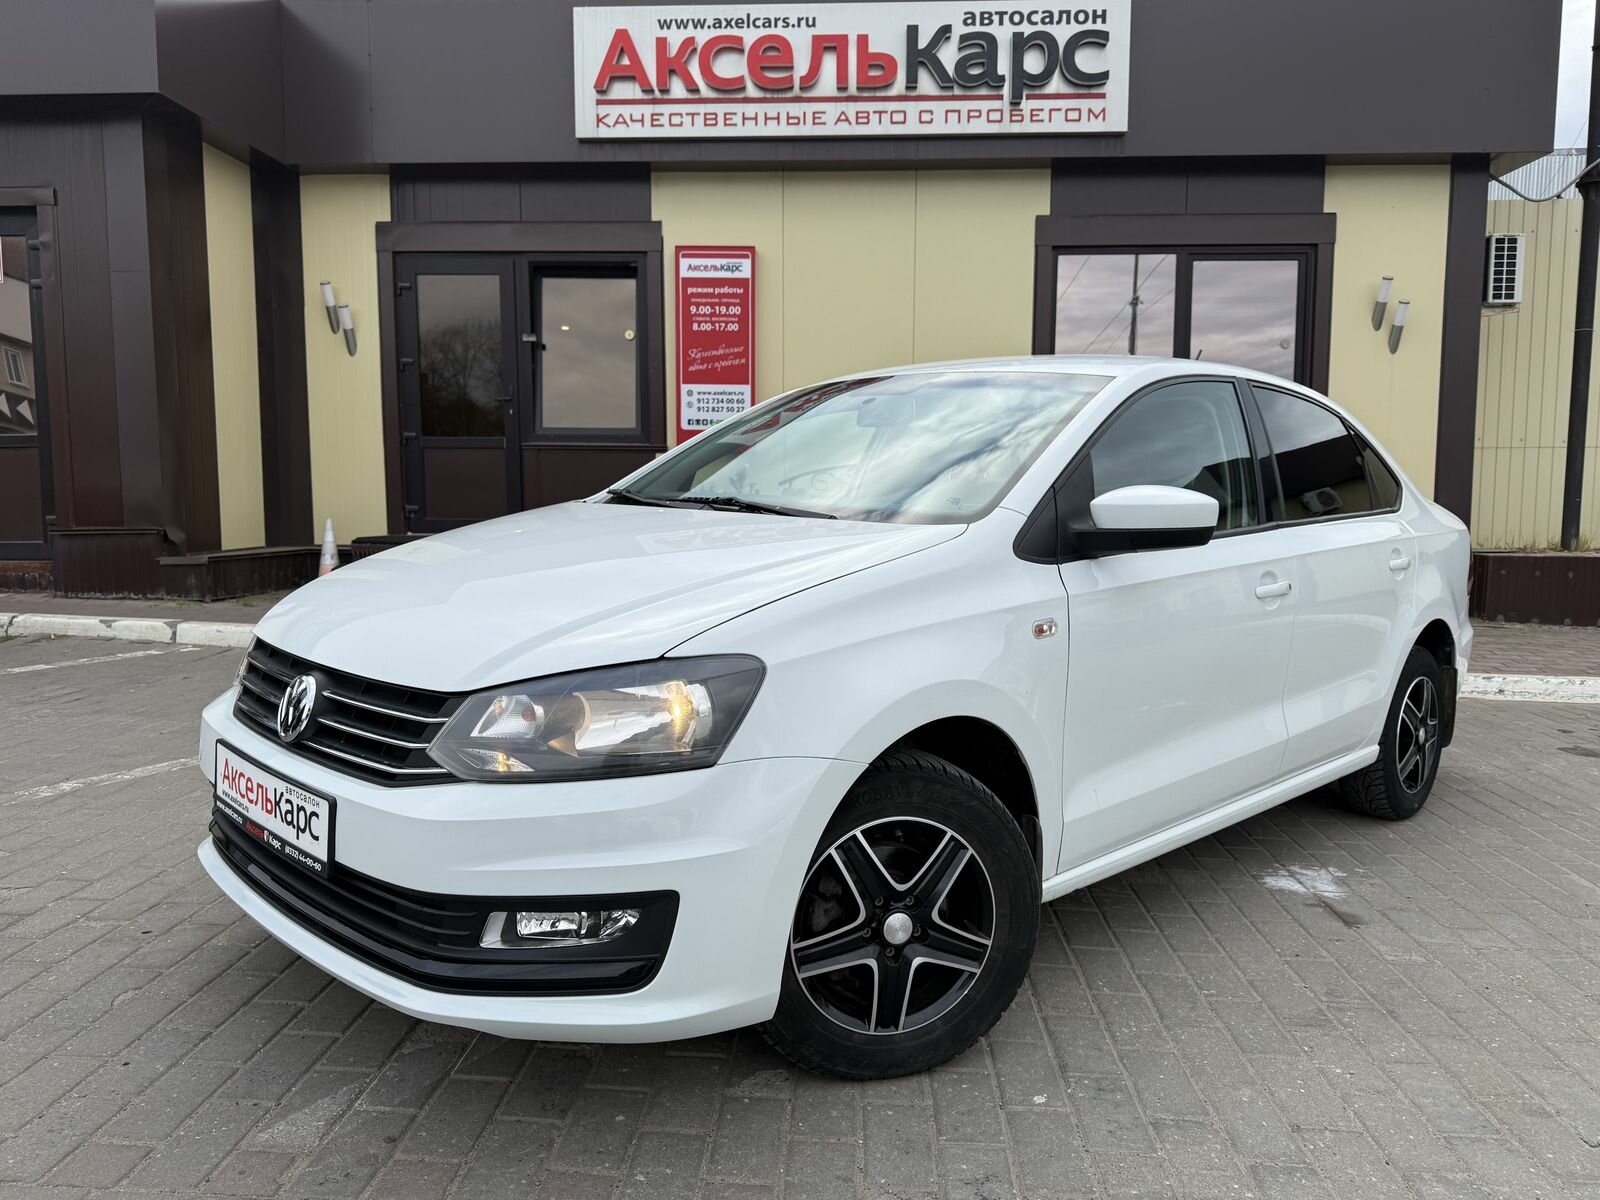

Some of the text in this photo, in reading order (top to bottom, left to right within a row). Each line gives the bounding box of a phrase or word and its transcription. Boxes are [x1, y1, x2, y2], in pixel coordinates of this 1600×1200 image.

[657, 13, 817, 30] www.axelcars.ru
[962, 8, 1107, 27] автосалон
[594, 24, 1110, 106] АксельКарс
[596, 107, 1107, 129] КАЧЕСТВЕННЫЕ АВТО С ПРОБЕГОМ
[687, 286, 744, 295] режим работы
[690, 305, 741, 315] 9.00-19.00
[692, 322, 739, 331] 8.00-17.00
[222, 758, 320, 841] АксельКарс
[284, 785, 320, 809] автосалон
